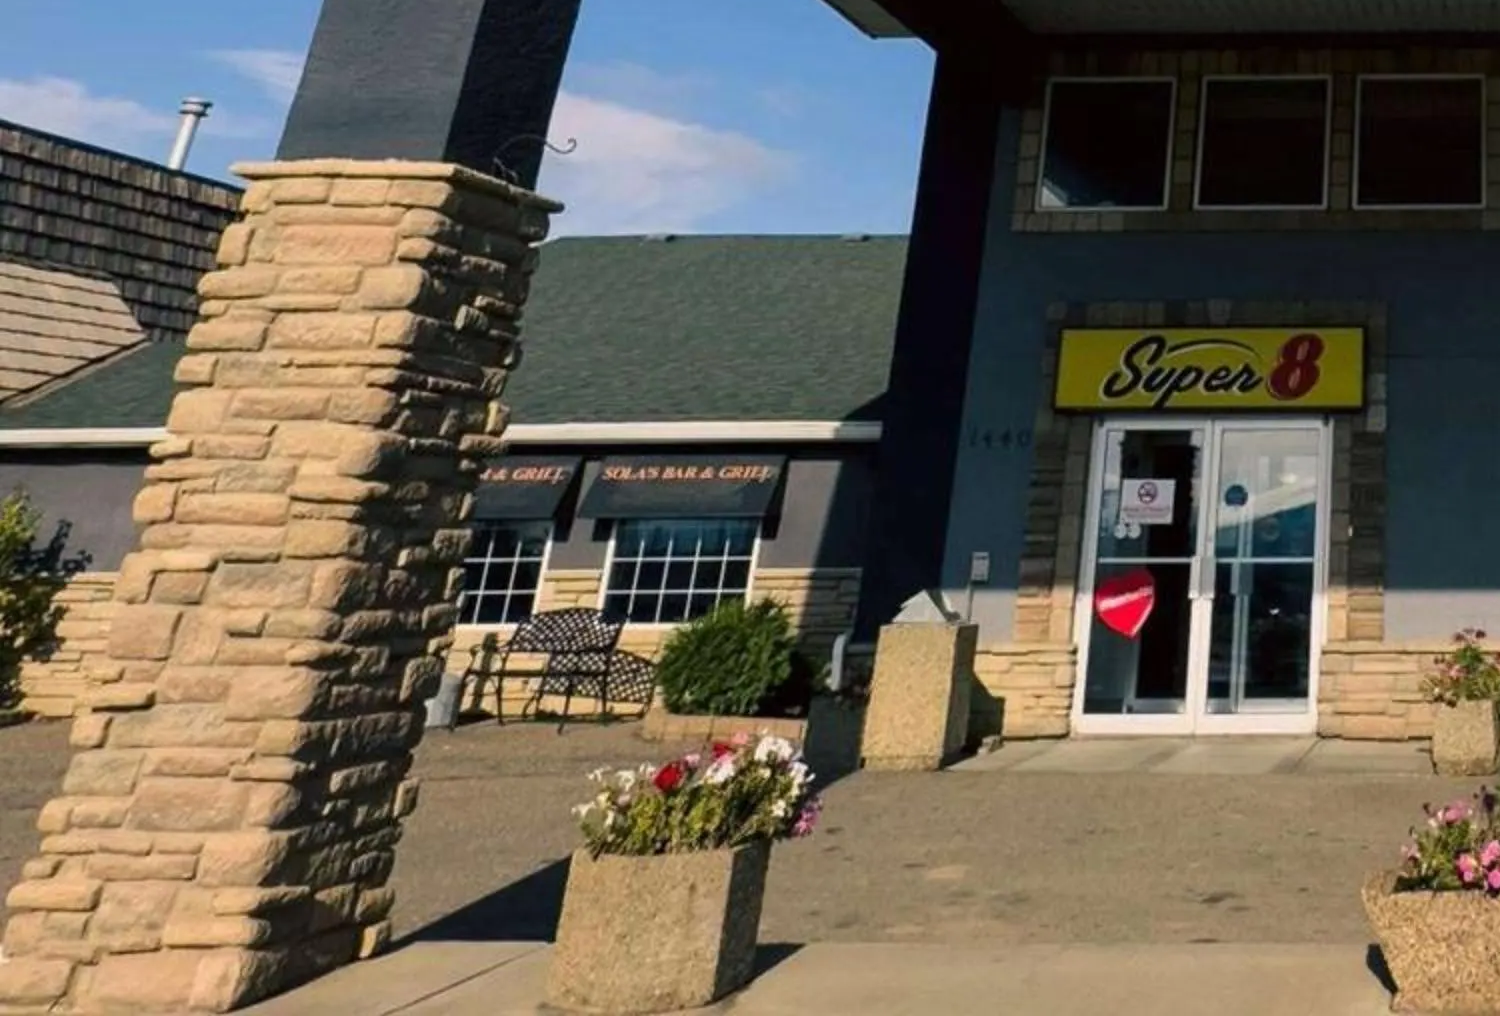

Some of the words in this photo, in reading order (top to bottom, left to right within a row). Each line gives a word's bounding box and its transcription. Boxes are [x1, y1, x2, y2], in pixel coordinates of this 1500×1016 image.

[1102, 335, 1264, 409] Super
[1267, 333, 1325, 401] 8
[661, 465, 698, 480] BAR
[700, 465, 715, 480] &
[718, 464, 772, 483] GRILL
